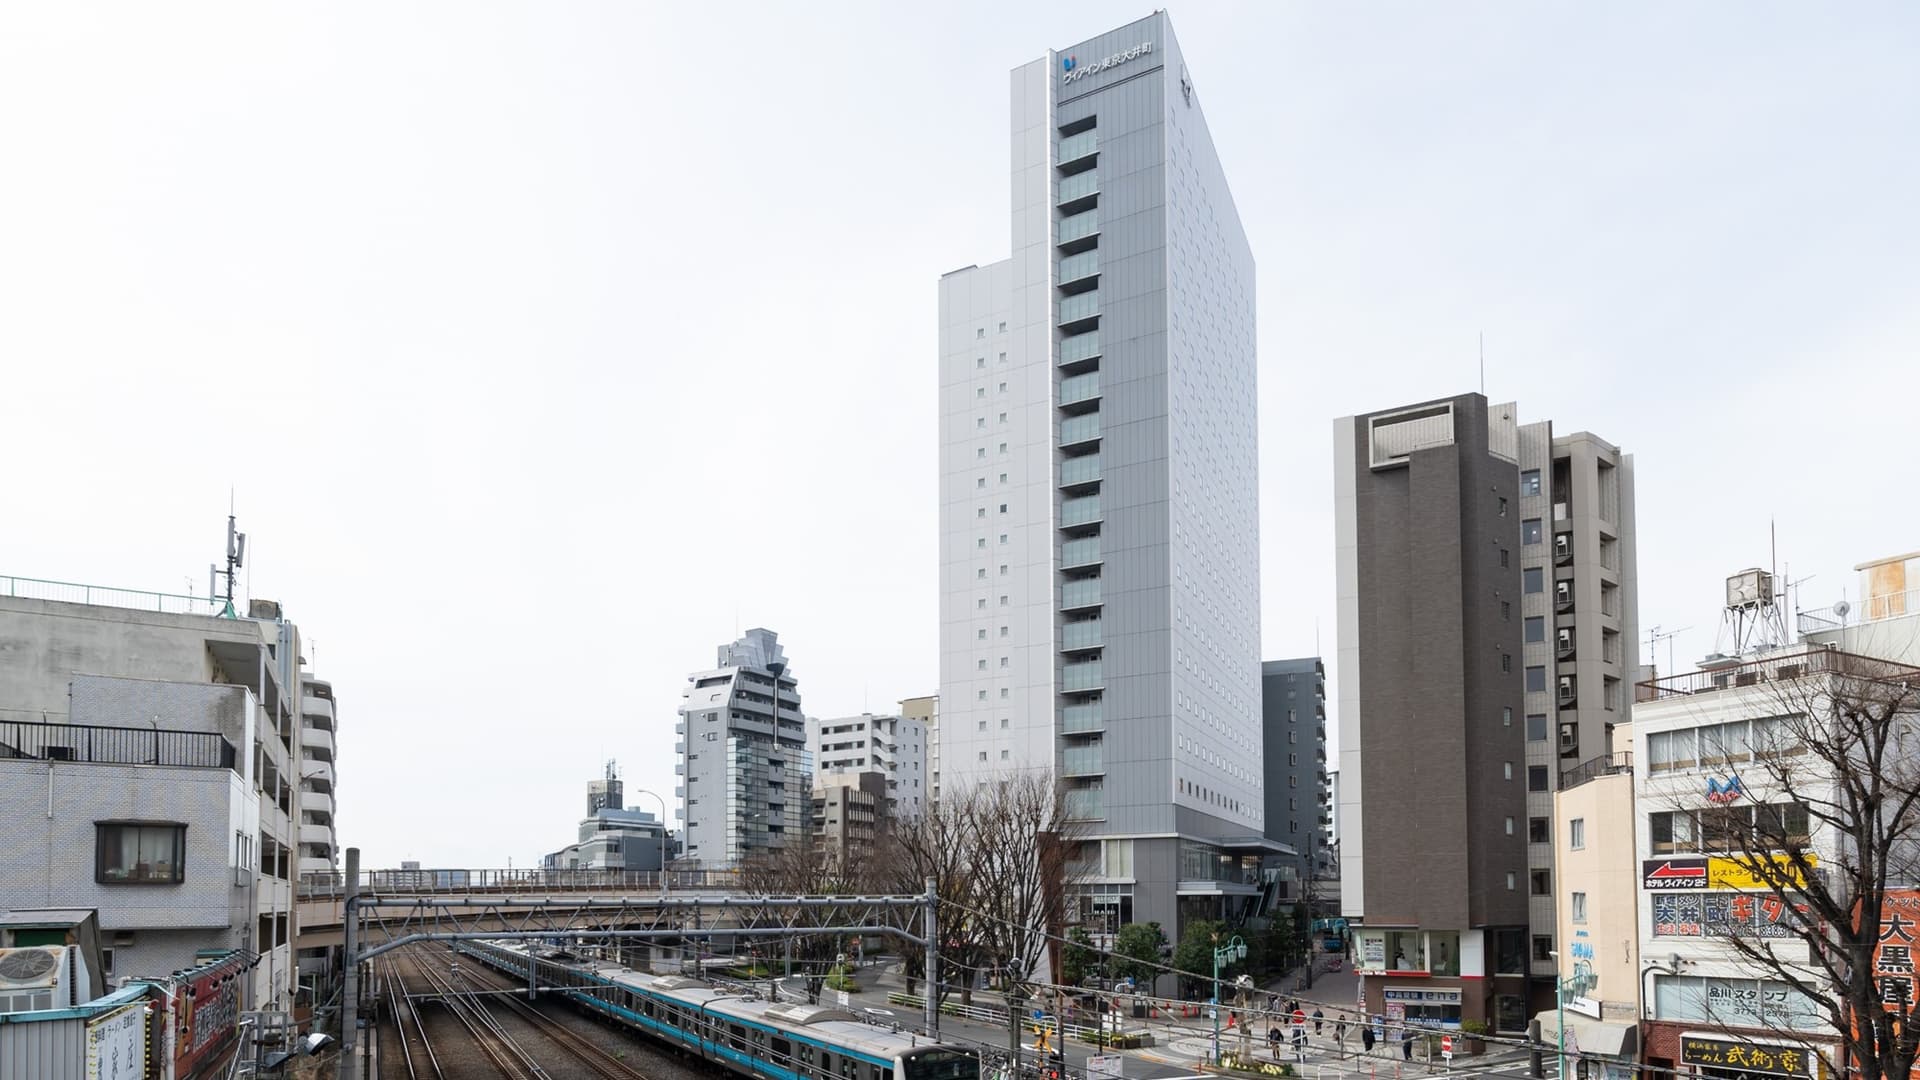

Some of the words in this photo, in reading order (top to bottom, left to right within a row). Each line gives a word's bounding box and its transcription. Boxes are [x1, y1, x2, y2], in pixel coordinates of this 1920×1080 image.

[1877, 912, 1917, 1006] 大黒屋
[1709, 987, 1788, 1002] 品川スタンプ
[1725, 1045, 1801, 1073] 武術家
